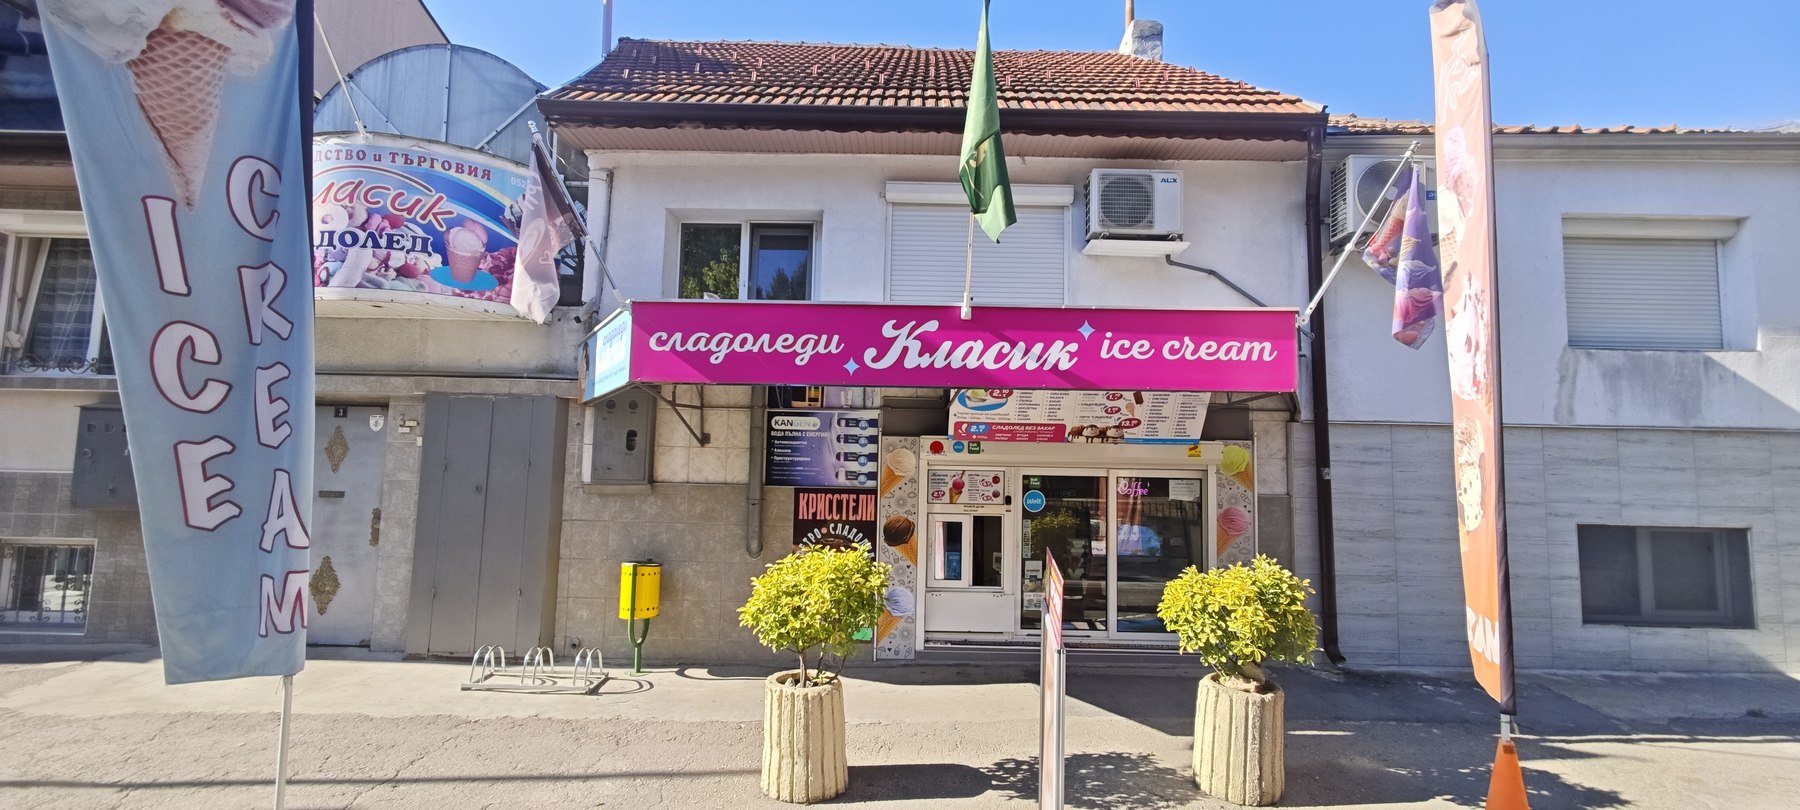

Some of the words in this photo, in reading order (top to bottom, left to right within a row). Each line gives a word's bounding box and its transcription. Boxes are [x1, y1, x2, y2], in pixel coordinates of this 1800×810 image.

[373, 153, 382, 162] и
[389, 152, 492, 181] ТЪРГОВИЯ
[511, 176, 530, 189] 052
[314, 229, 433, 257] ДОЛЕД
[648, 331, 844, 366] сладоледи
[863, 319, 1079, 369] Класик
[1099, 331, 1156, 360] ice
[1161, 335, 1277, 361] cream
[141, 195, 242, 532] ICE
[226, 154, 310, 638] CREAM
[338, 408, 343, 416] 3
[774, 418, 812, 427] KANGEN
[1117, 480, 1149, 497] Coffee
[798, 493, 876, 521] КРИССТЕЛИ
